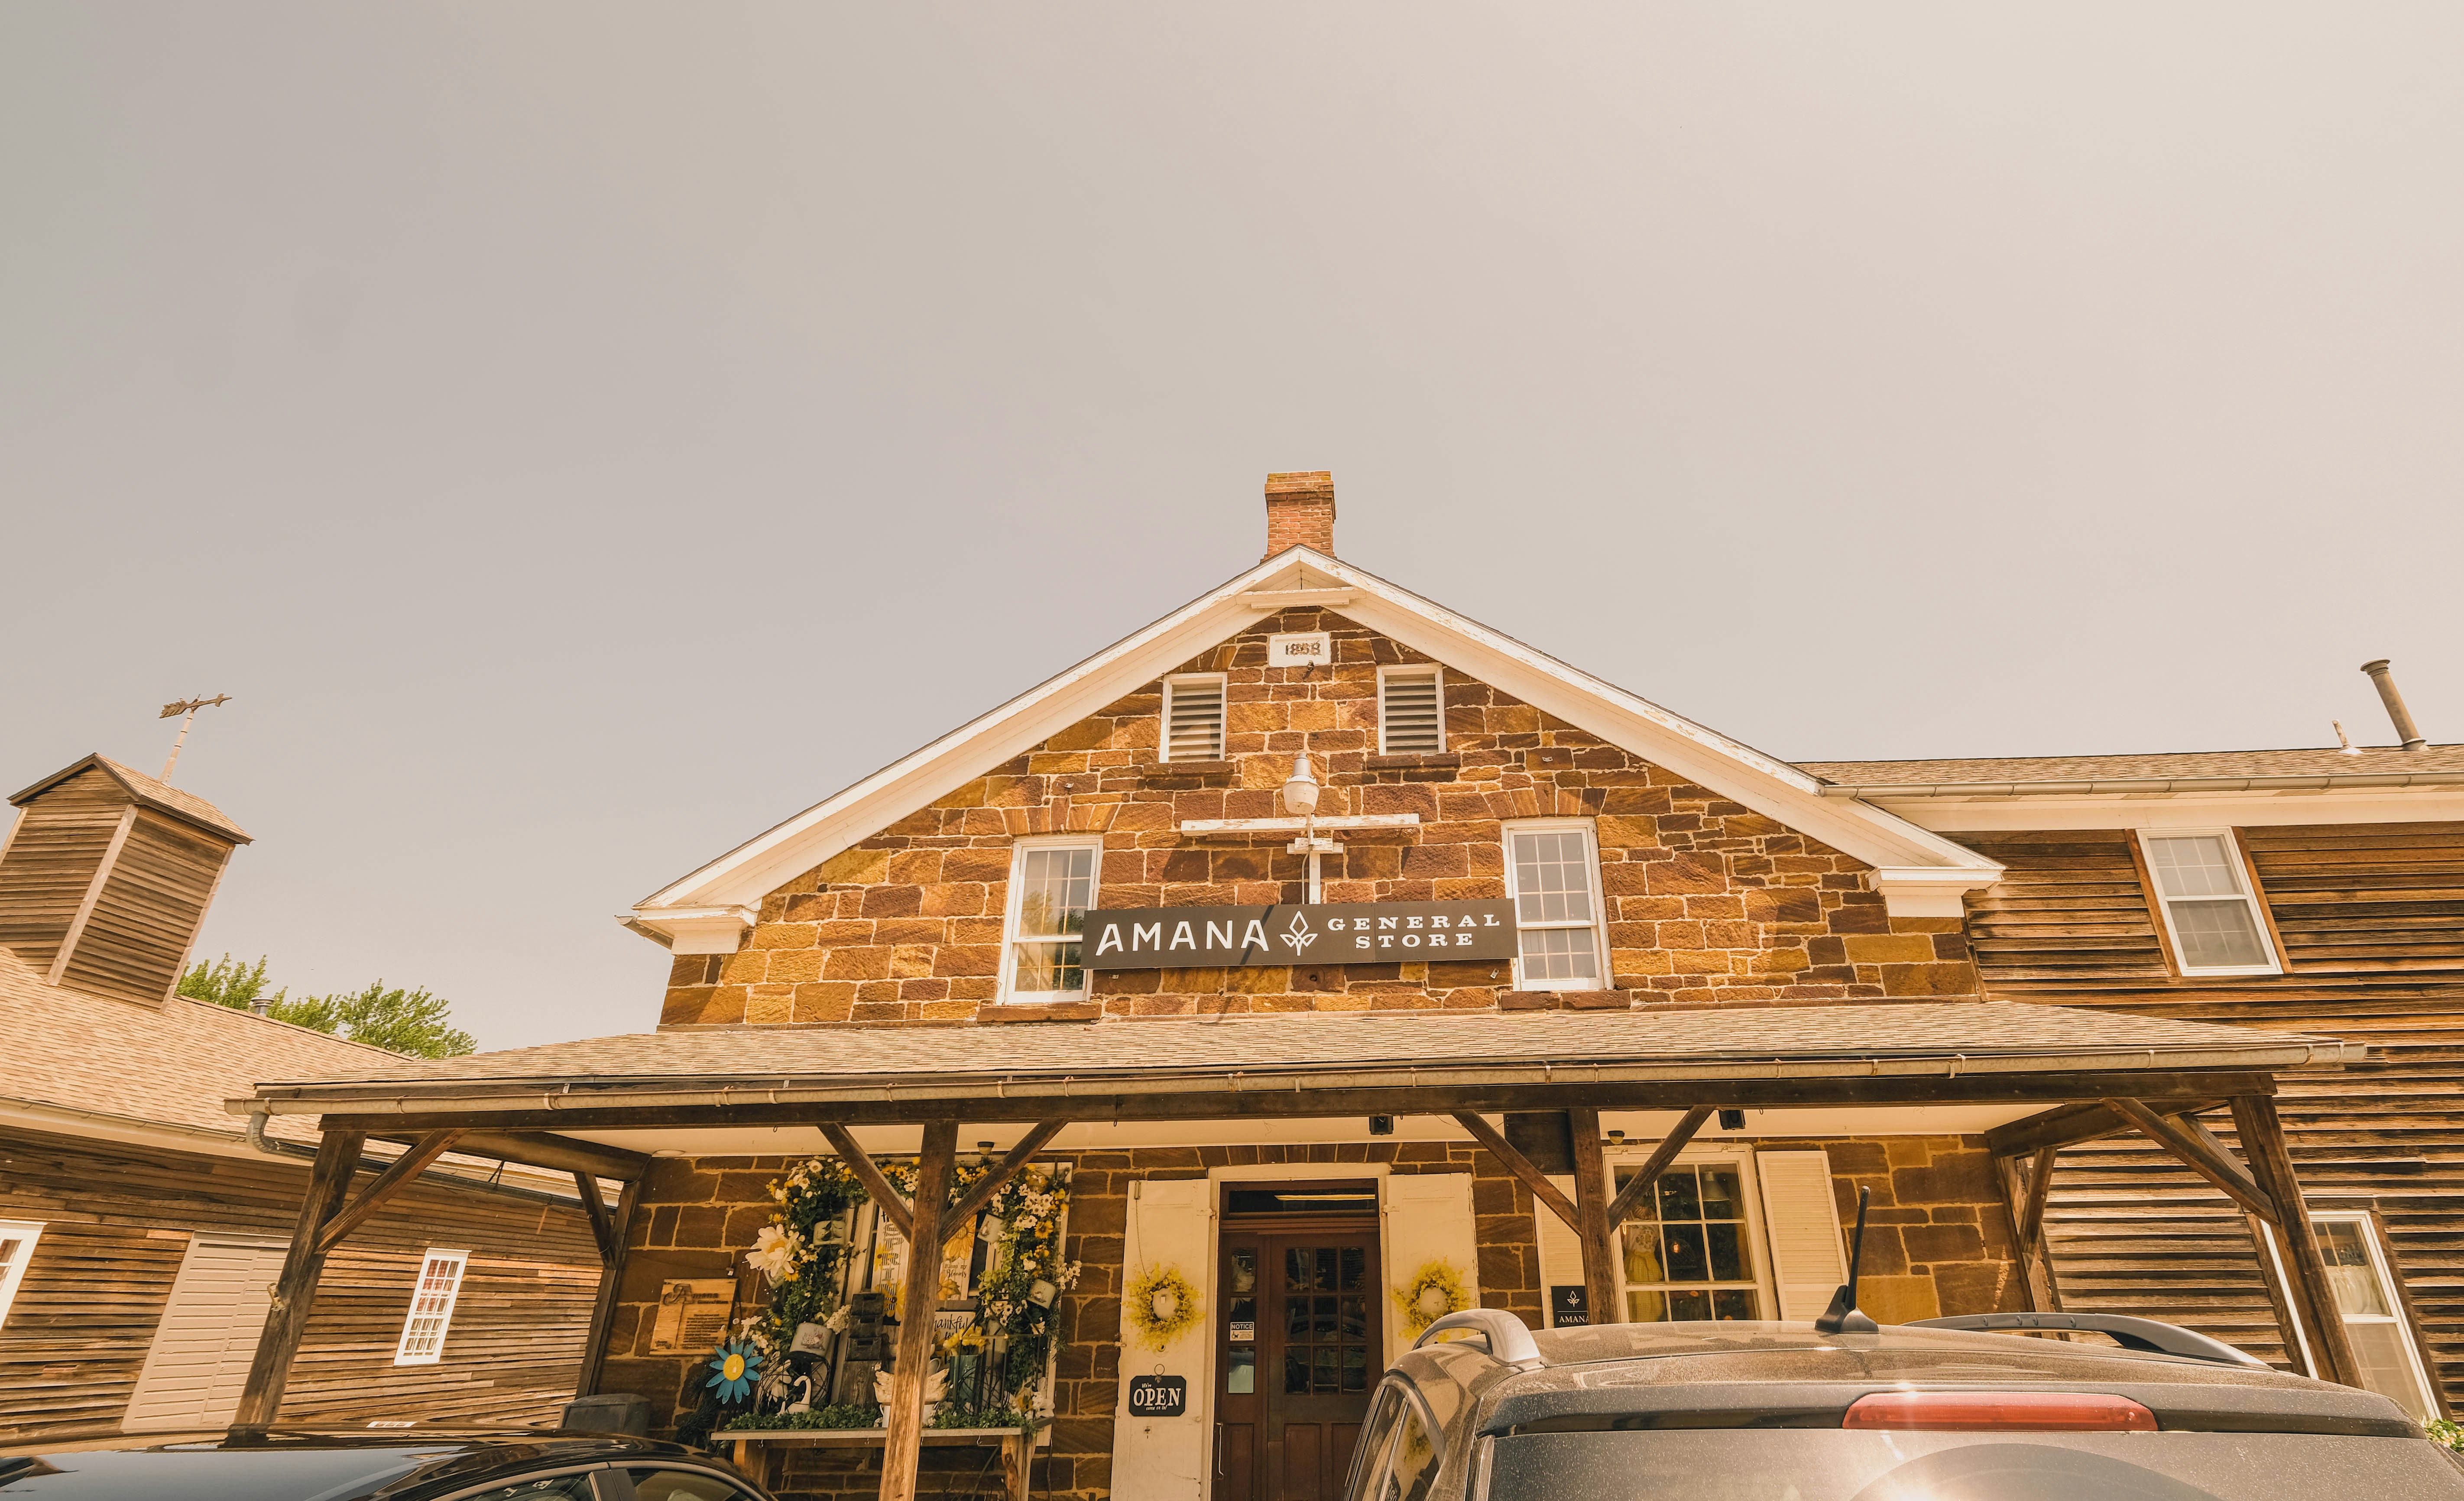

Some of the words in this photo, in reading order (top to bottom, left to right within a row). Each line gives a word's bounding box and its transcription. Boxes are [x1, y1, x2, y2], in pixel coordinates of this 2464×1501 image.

[1327, 914, 1500, 931] GENERAL
[1095, 919, 1269, 956] AMANA
[1355, 933, 1473, 949] STORE
[1134, 1388, 1181, 1406] OPEN
